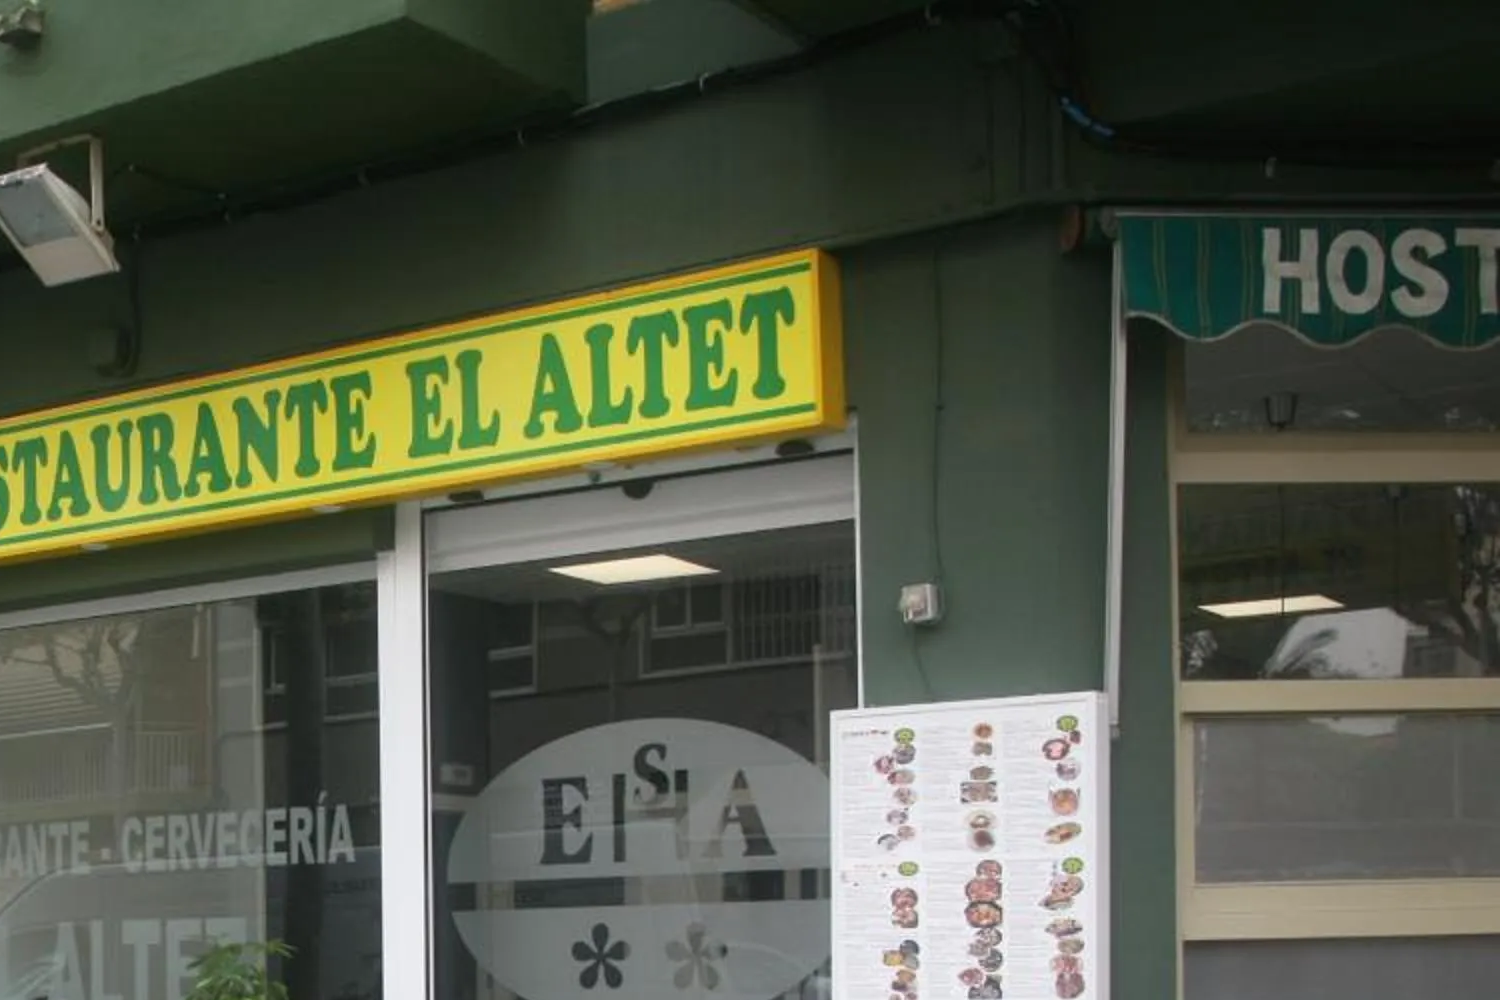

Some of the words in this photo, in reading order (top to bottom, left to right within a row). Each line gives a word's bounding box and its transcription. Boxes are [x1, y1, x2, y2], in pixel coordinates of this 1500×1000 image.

[406, 349, 500, 459] EL
[523, 286, 796, 440] ALTET
[120, 790, 356, 873] CERVECERÍA
